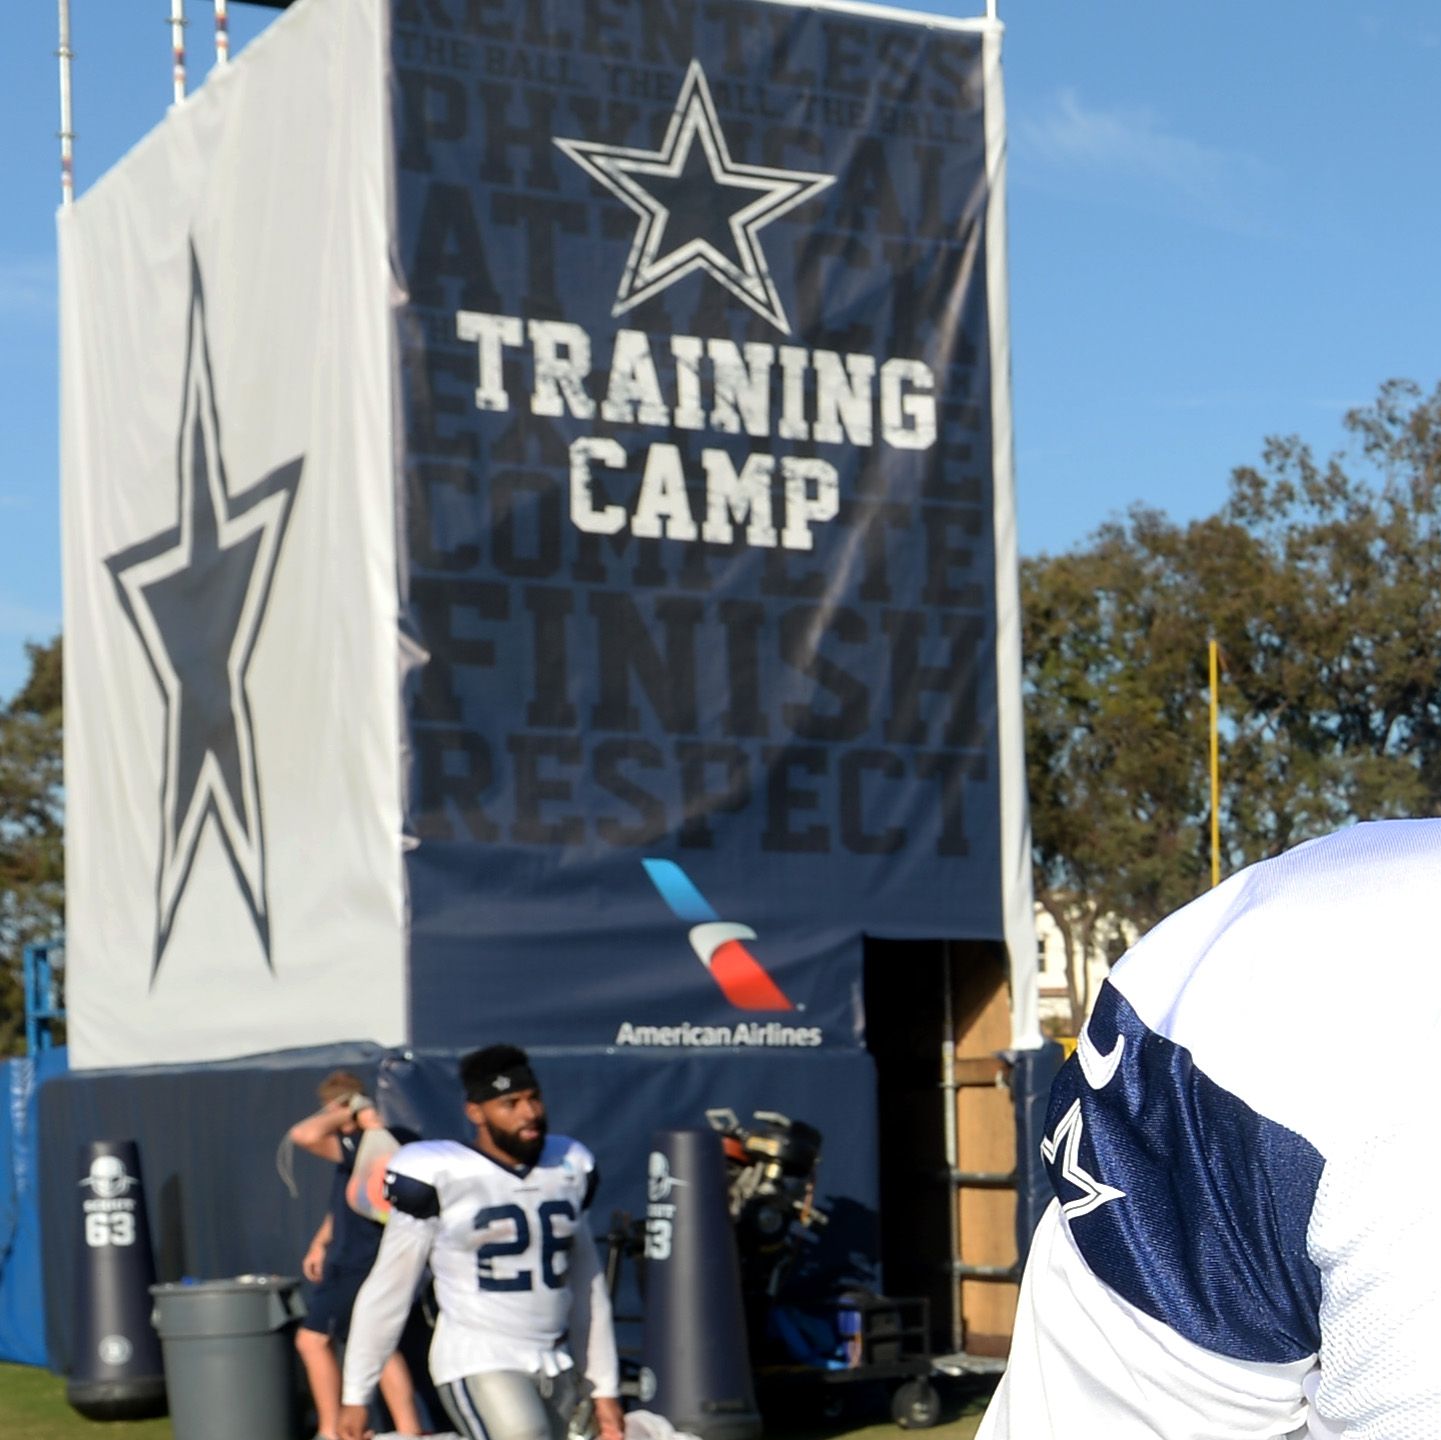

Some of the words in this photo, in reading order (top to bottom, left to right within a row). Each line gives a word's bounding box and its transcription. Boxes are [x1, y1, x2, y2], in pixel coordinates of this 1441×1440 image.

[406, 181, 982, 362] ATCK
[456, 310, 937, 451] TRAINING
[569, 436, 840, 550] CAMP
[409, 577, 986, 748] FINISH
[411, 730, 989, 860] RESPECT
[616, 1021, 731, 1046] American
[732, 1022, 822, 1046] Airlines
[85, 1211, 136, 1247] 63
[474, 1200, 575, 1292] 26
[644, 1219, 672, 1260] 3
